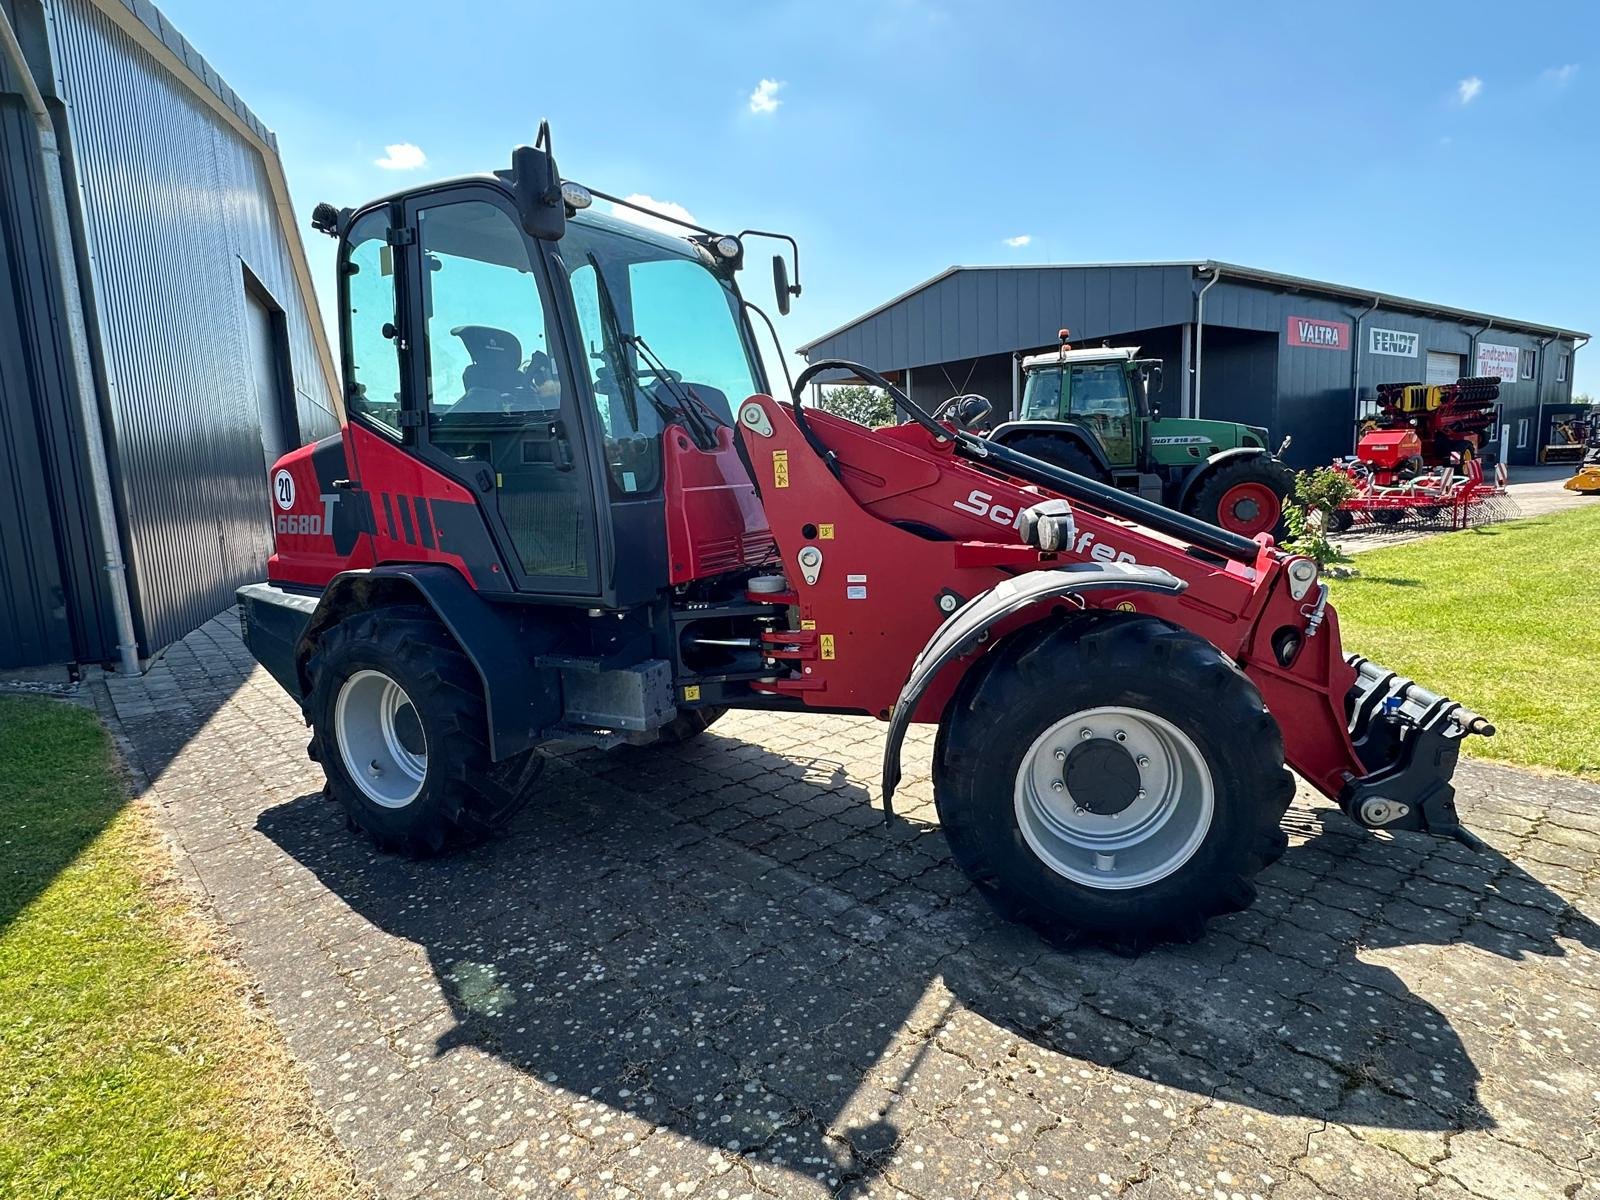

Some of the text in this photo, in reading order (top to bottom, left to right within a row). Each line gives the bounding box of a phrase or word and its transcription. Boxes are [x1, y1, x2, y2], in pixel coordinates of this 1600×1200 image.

[1298, 320, 1339, 345] VALTRA
[1372, 331, 1417, 354] FENDT
[1478, 343, 1518, 363] Landtechnik
[279, 478, 292, 502] 20
